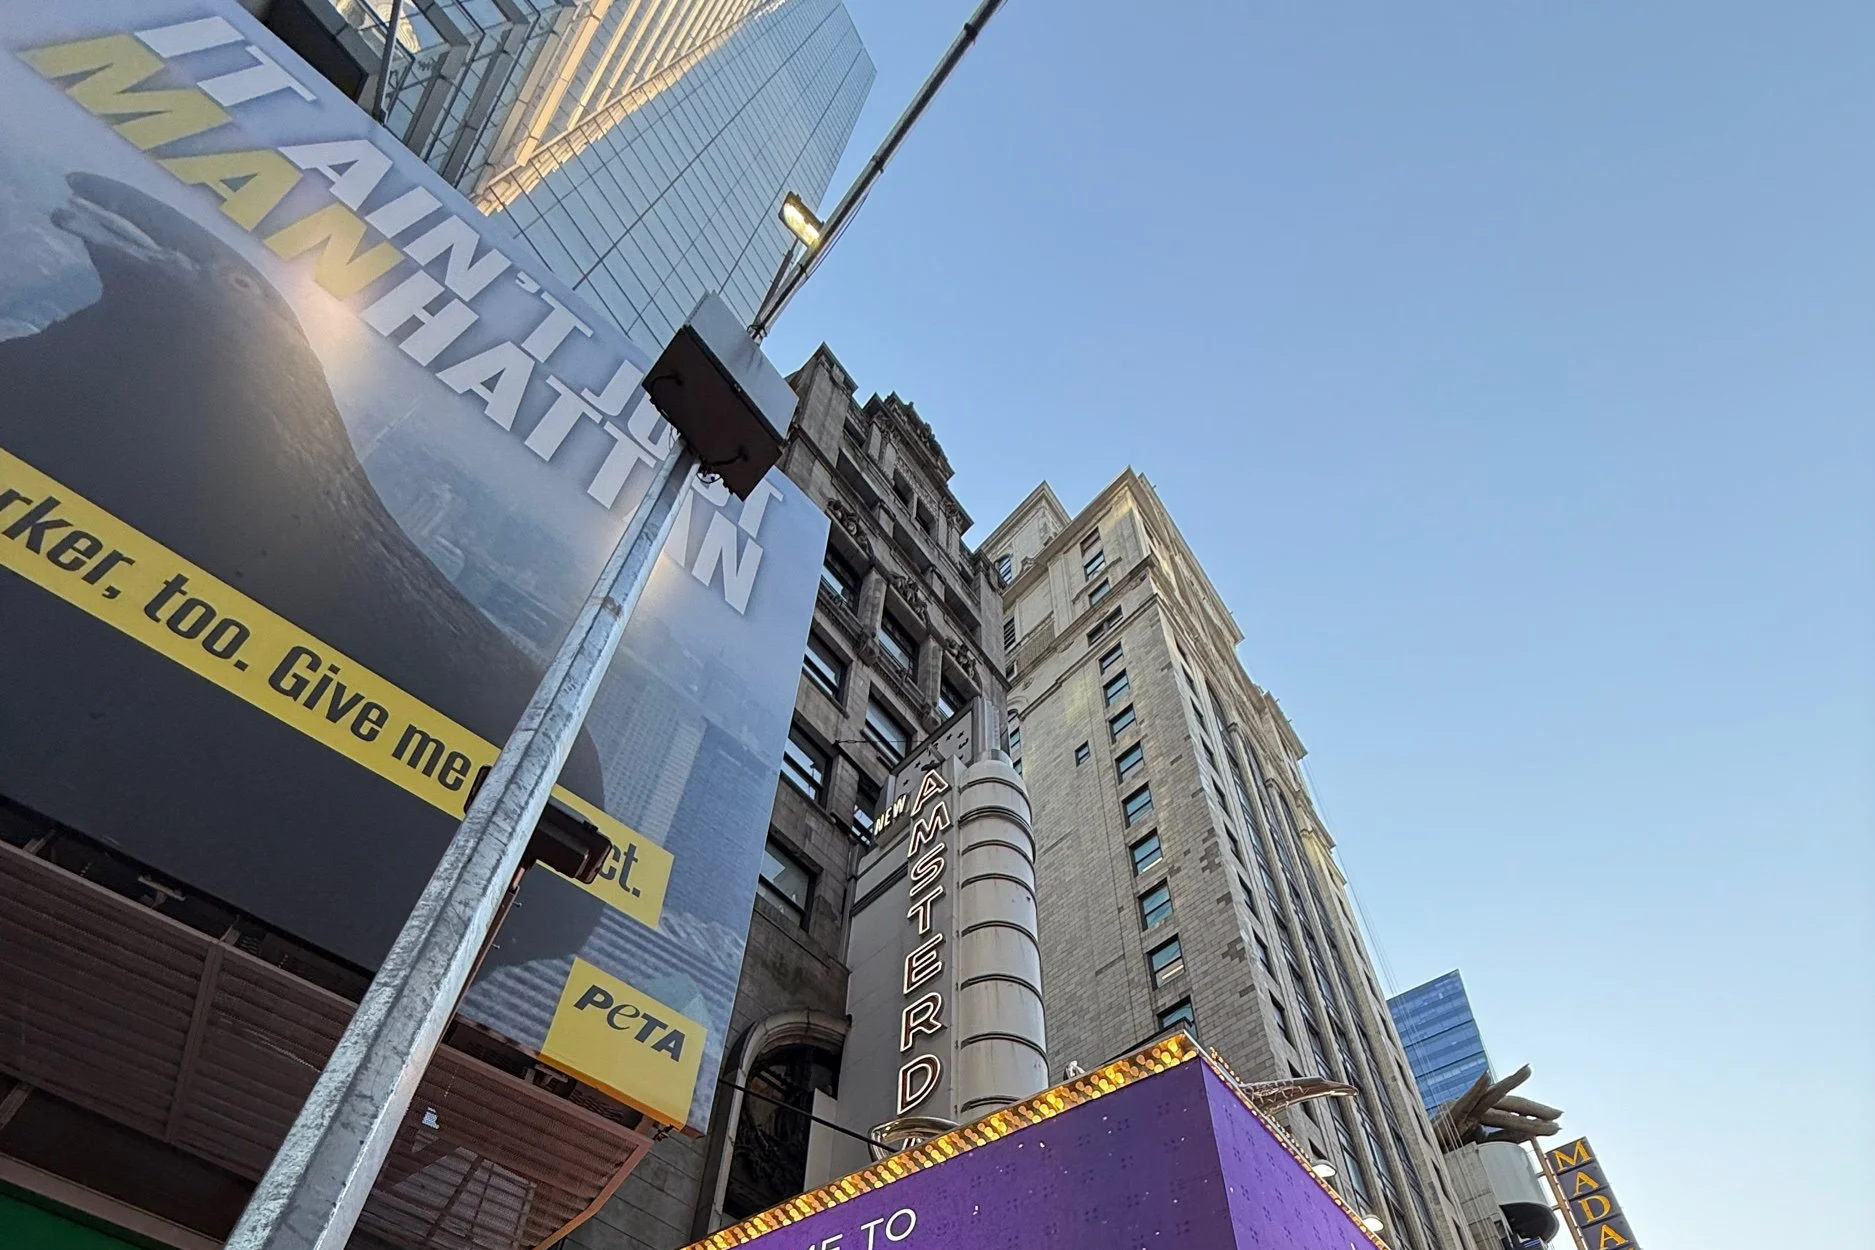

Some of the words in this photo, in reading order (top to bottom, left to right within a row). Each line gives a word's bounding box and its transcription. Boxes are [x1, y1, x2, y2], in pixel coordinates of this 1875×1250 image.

[135, 16, 318, 106] IT
[277, 139, 594, 364] AIN'T
[142, 573, 251, 672] too.
[267, 644, 390, 744] Give
[391, 722, 473, 792] me
[873, 794, 909, 836] NEW
